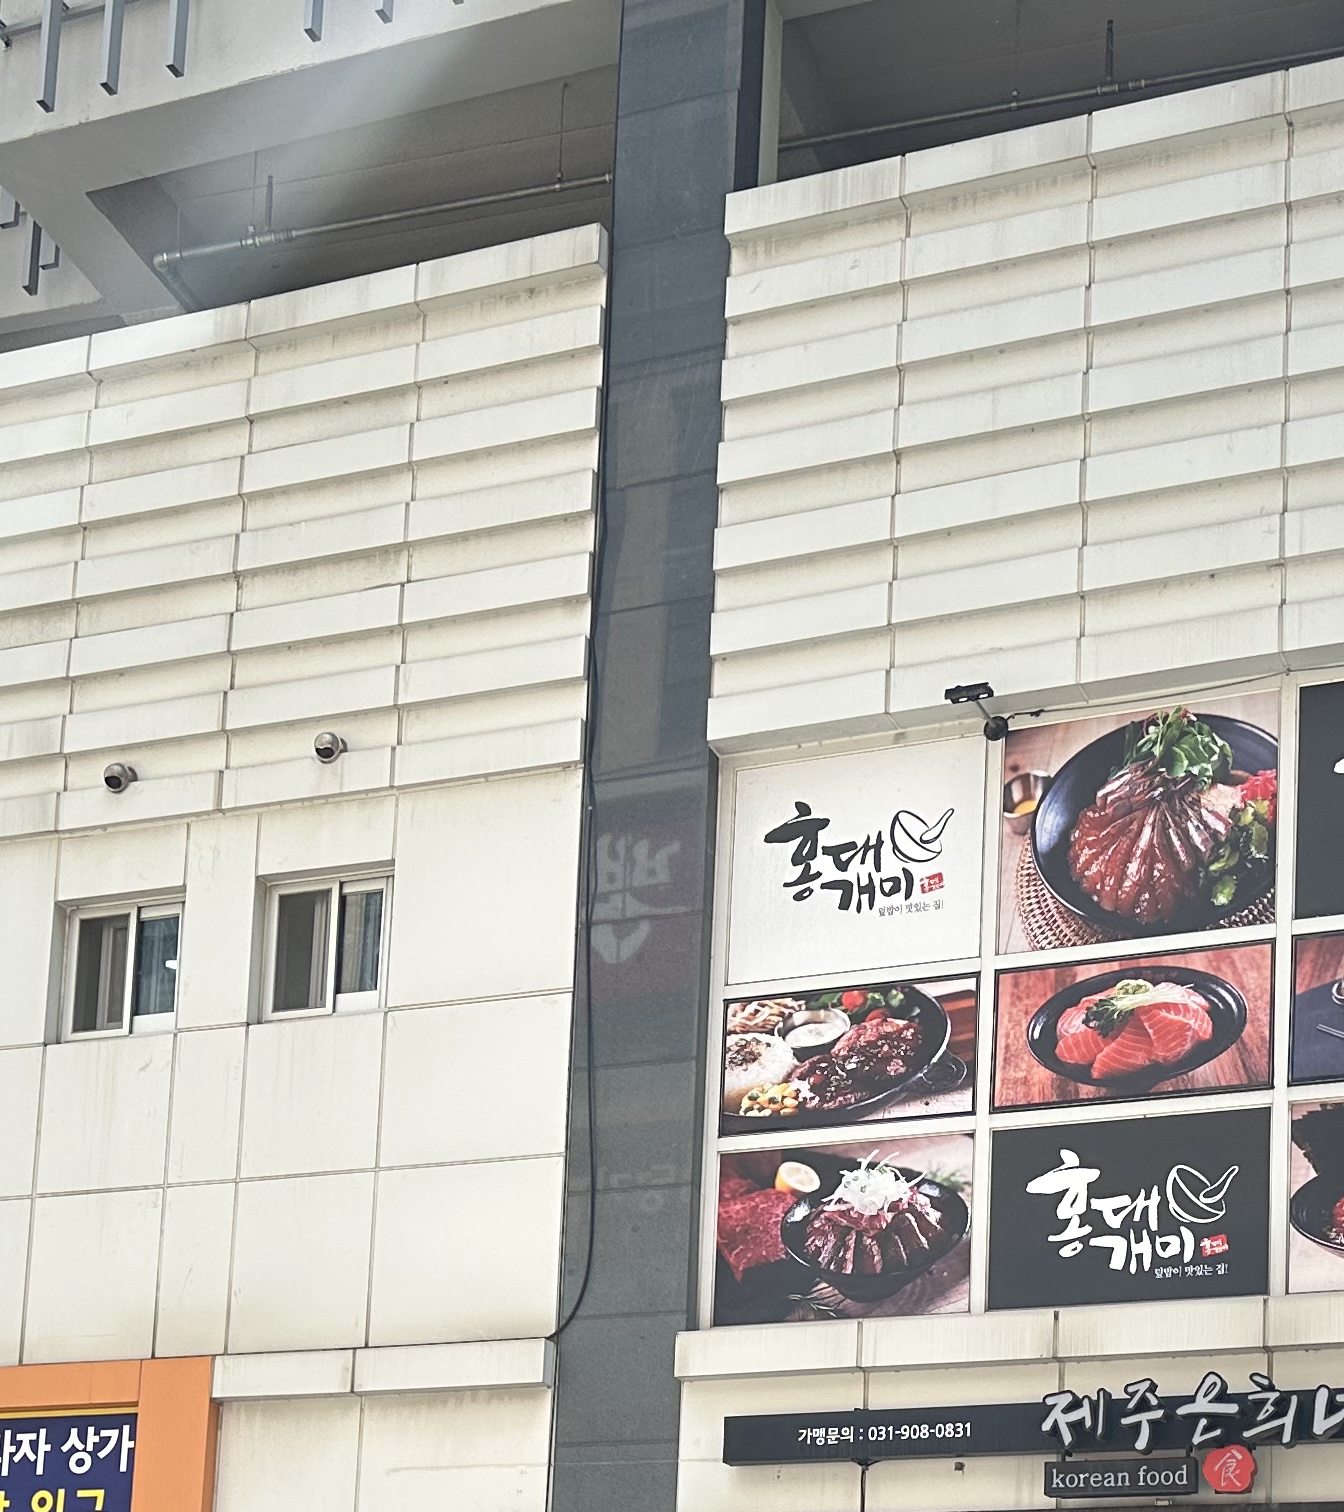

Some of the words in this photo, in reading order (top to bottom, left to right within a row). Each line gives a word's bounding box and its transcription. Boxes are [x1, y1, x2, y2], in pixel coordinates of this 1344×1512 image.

[1184, 1263, 1213, 1276] 맛있는
[797, 1426, 854, 1446] 가맹문의
[867, 1421, 972, 1442] 031-908-0831
[60, 1424, 135, 1475] 상가
[1051, 1467, 1131, 1490] korean
[1137, 1464, 1188, 1487] food
